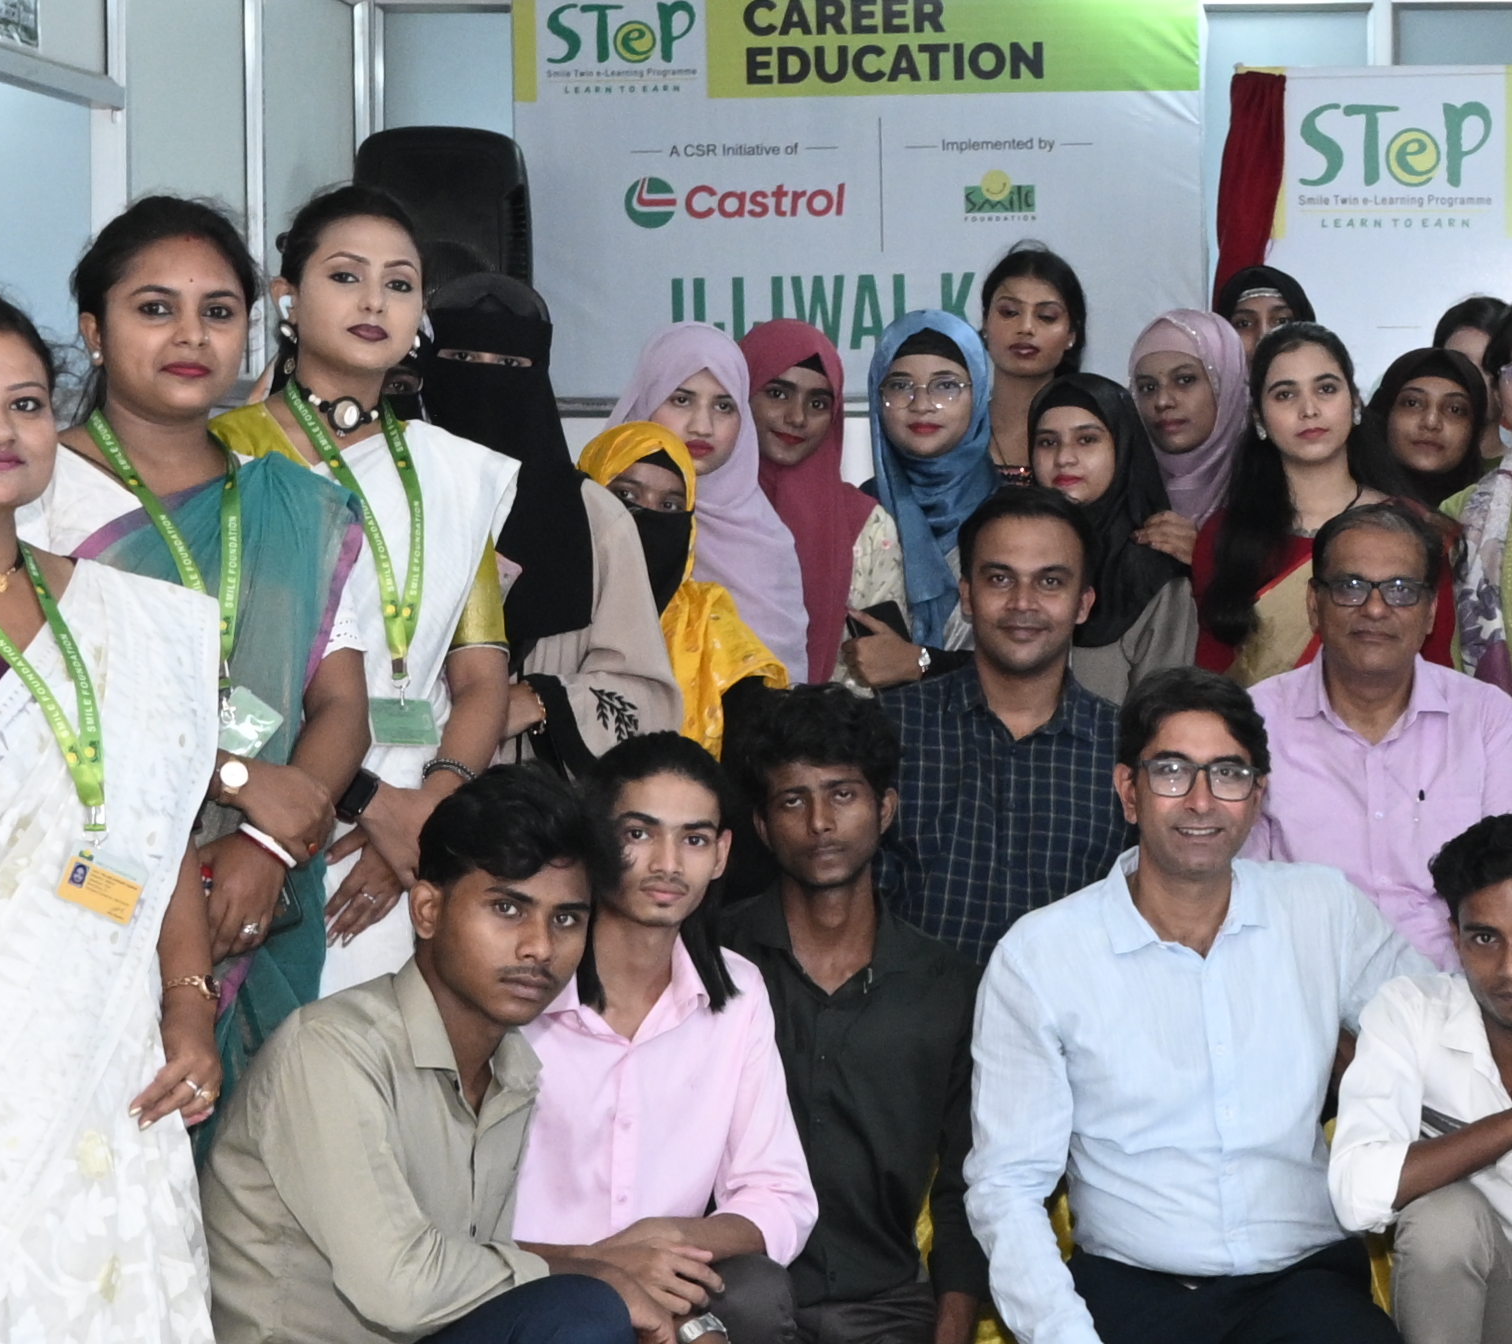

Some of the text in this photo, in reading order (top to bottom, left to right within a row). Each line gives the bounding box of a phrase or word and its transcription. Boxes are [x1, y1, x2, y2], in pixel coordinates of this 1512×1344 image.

[546, 67, 698, 79] Smile Twin e-Learning Programme
[745, 41, 1045, 85] EDUCATION
[564, 84, 681, 94] LEARN TO EARN
[668, 141, 799, 157] A CSR Initiative of
[941, 137, 1055, 154] Implemented by
[684, 182, 846, 219] Castrol
[1298, 194, 1492, 208] Smile Twin e-Learning Programme
[1321, 218, 1471, 229] LEARN TO EARN
[312, 426, 332, 451] SMILE
[159, 514, 194, 571] FOUNDATION
[225, 516, 237, 608] SMILE FOUNDATION
[381, 560, 395, 592] SMILE
[410, 565, 420, 596] SMILE
[59, 633, 97, 733] SMILE FOUNDATION
[46, 703, 70, 738] SMILE
